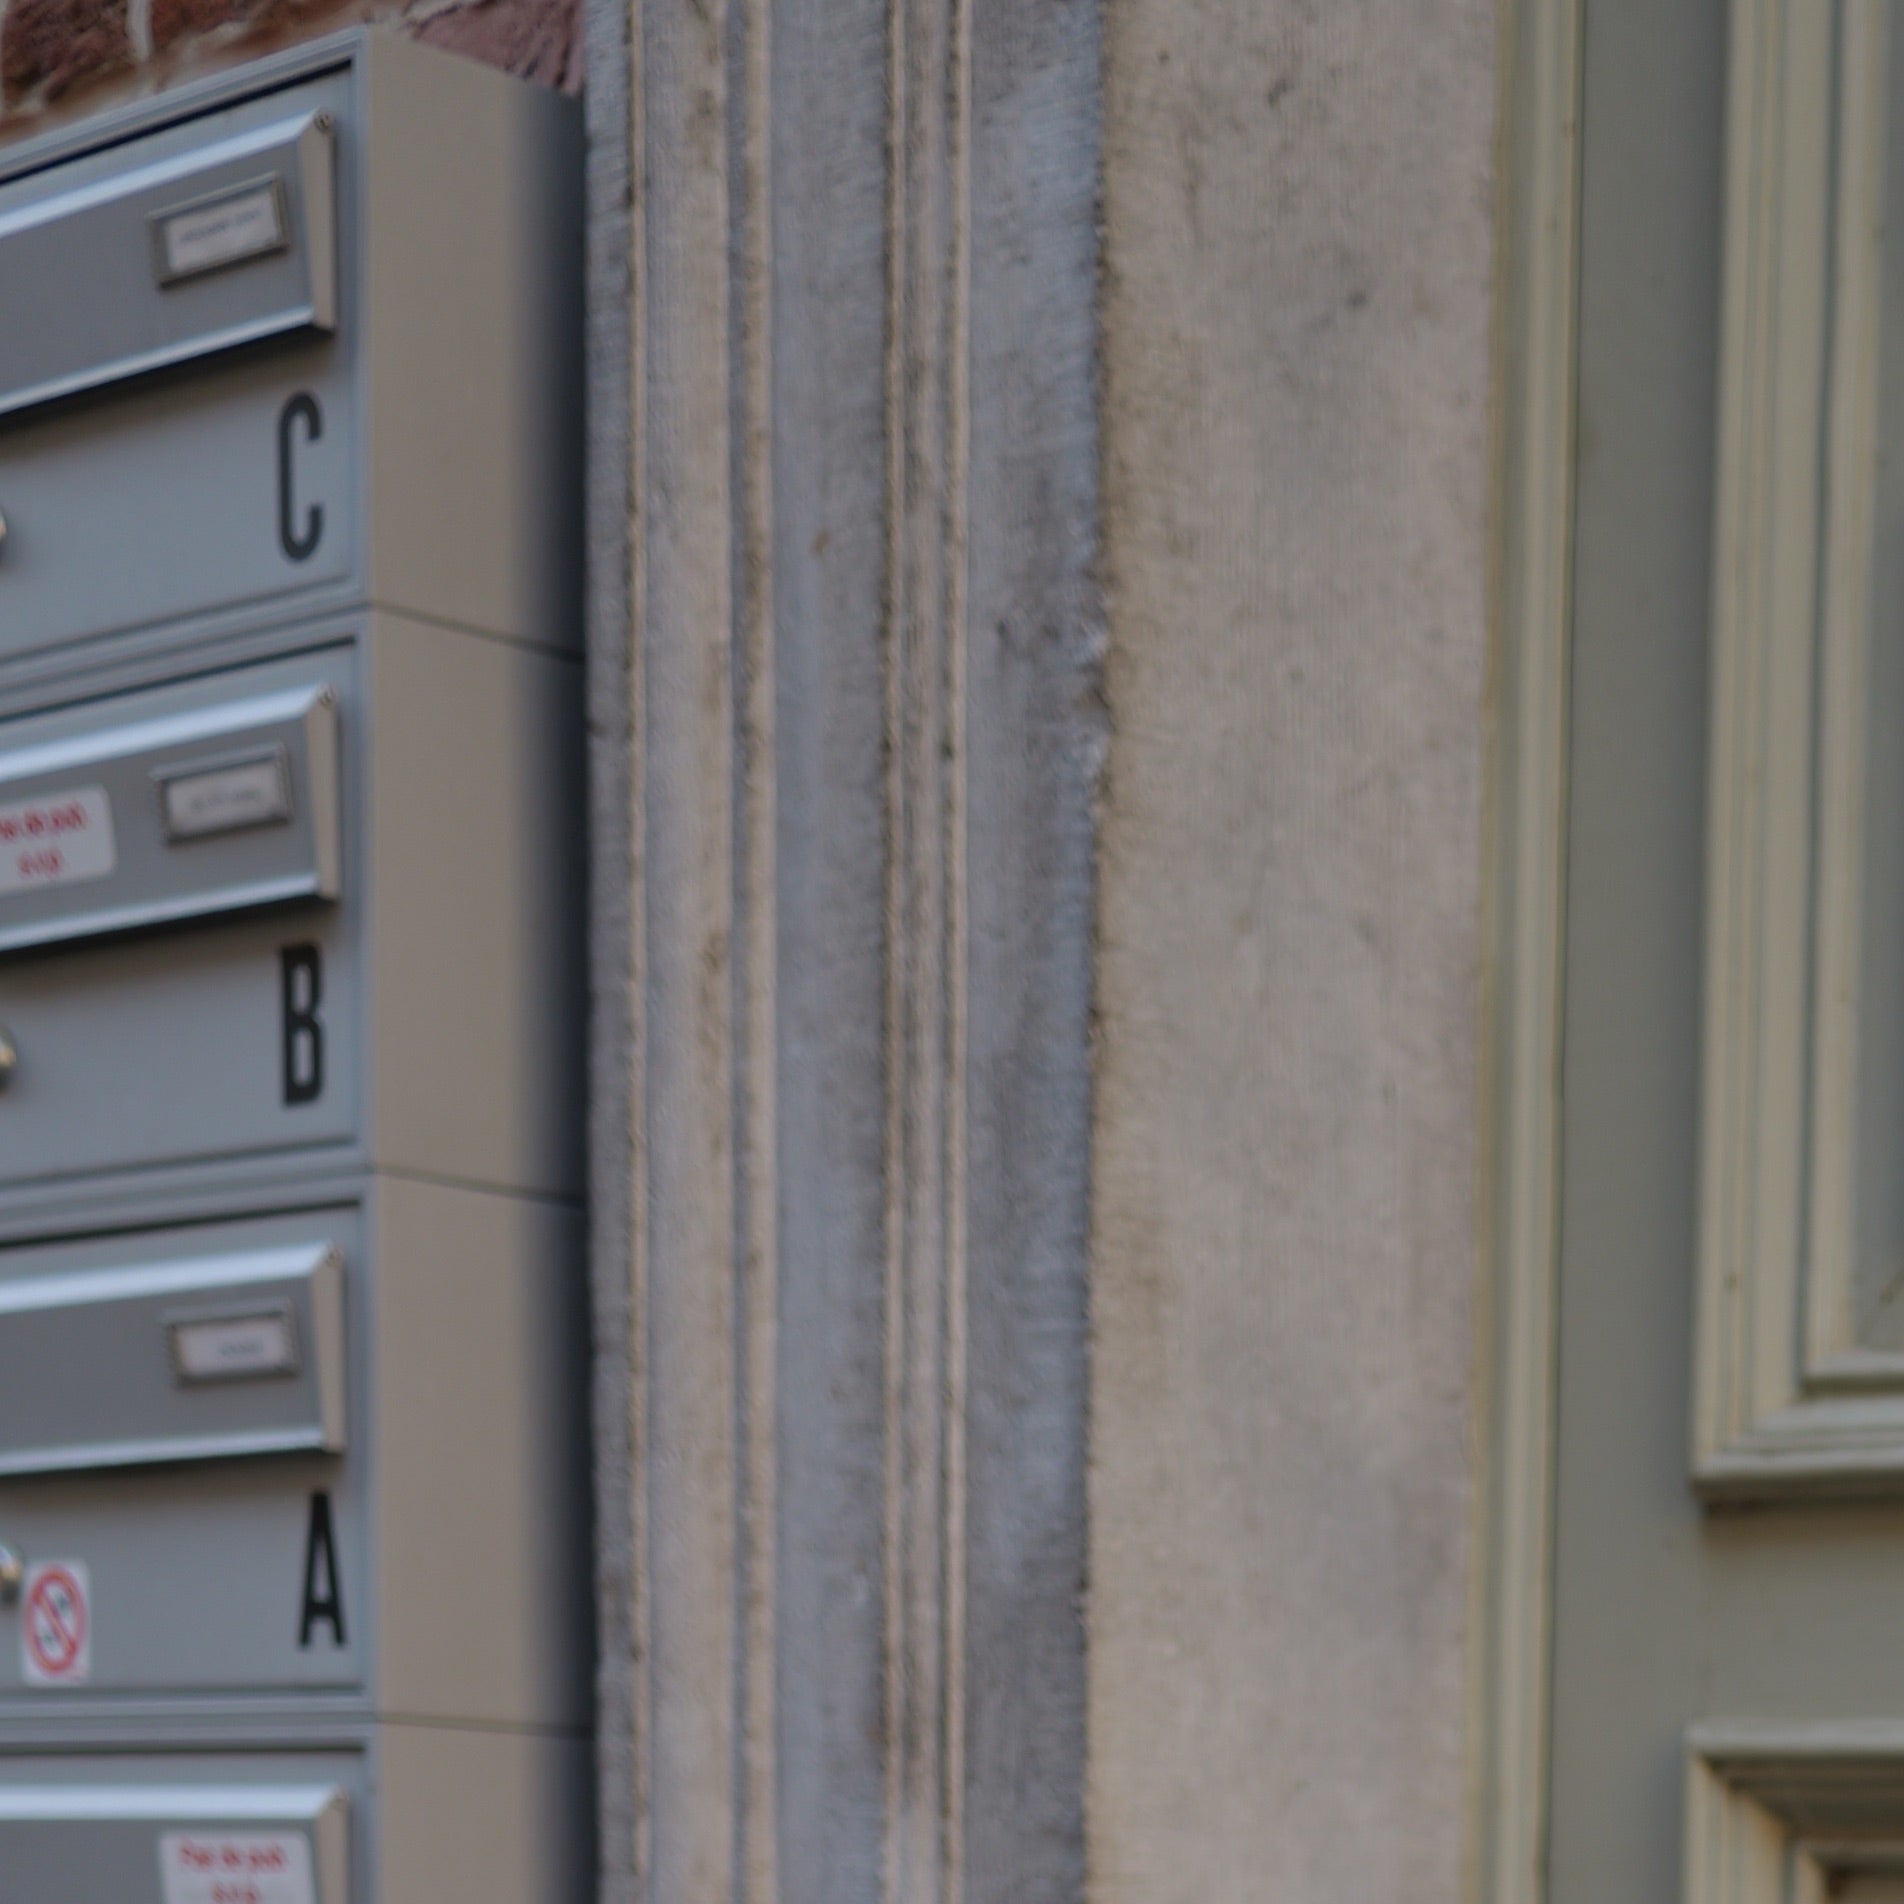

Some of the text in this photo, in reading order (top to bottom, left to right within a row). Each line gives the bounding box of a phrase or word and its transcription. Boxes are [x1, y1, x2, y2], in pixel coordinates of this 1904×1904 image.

[276, 391, 323, 563] C
[280, 942, 325, 1107] B
[298, 1490, 347, 1649] A
